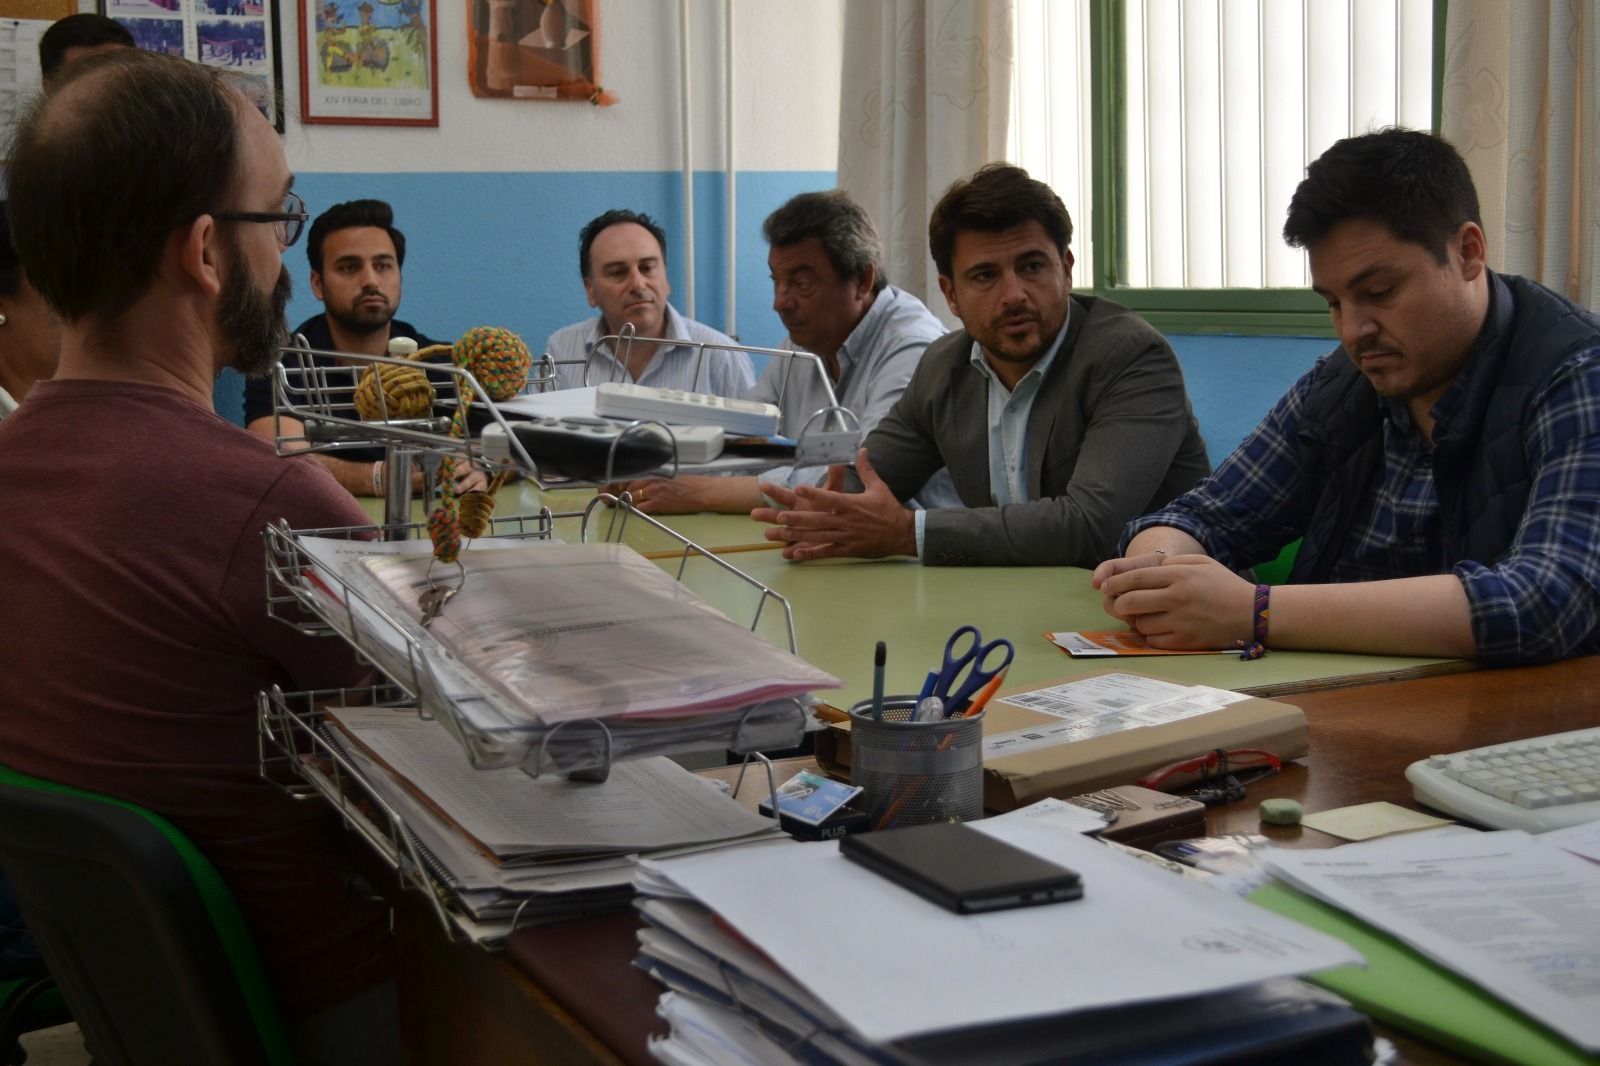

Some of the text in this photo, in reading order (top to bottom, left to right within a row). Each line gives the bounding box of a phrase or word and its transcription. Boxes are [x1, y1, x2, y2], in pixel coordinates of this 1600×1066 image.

[324, 96, 422, 106] XIV FERIA DEL LIBRO
[821, 825, 847, 838] PLUS
